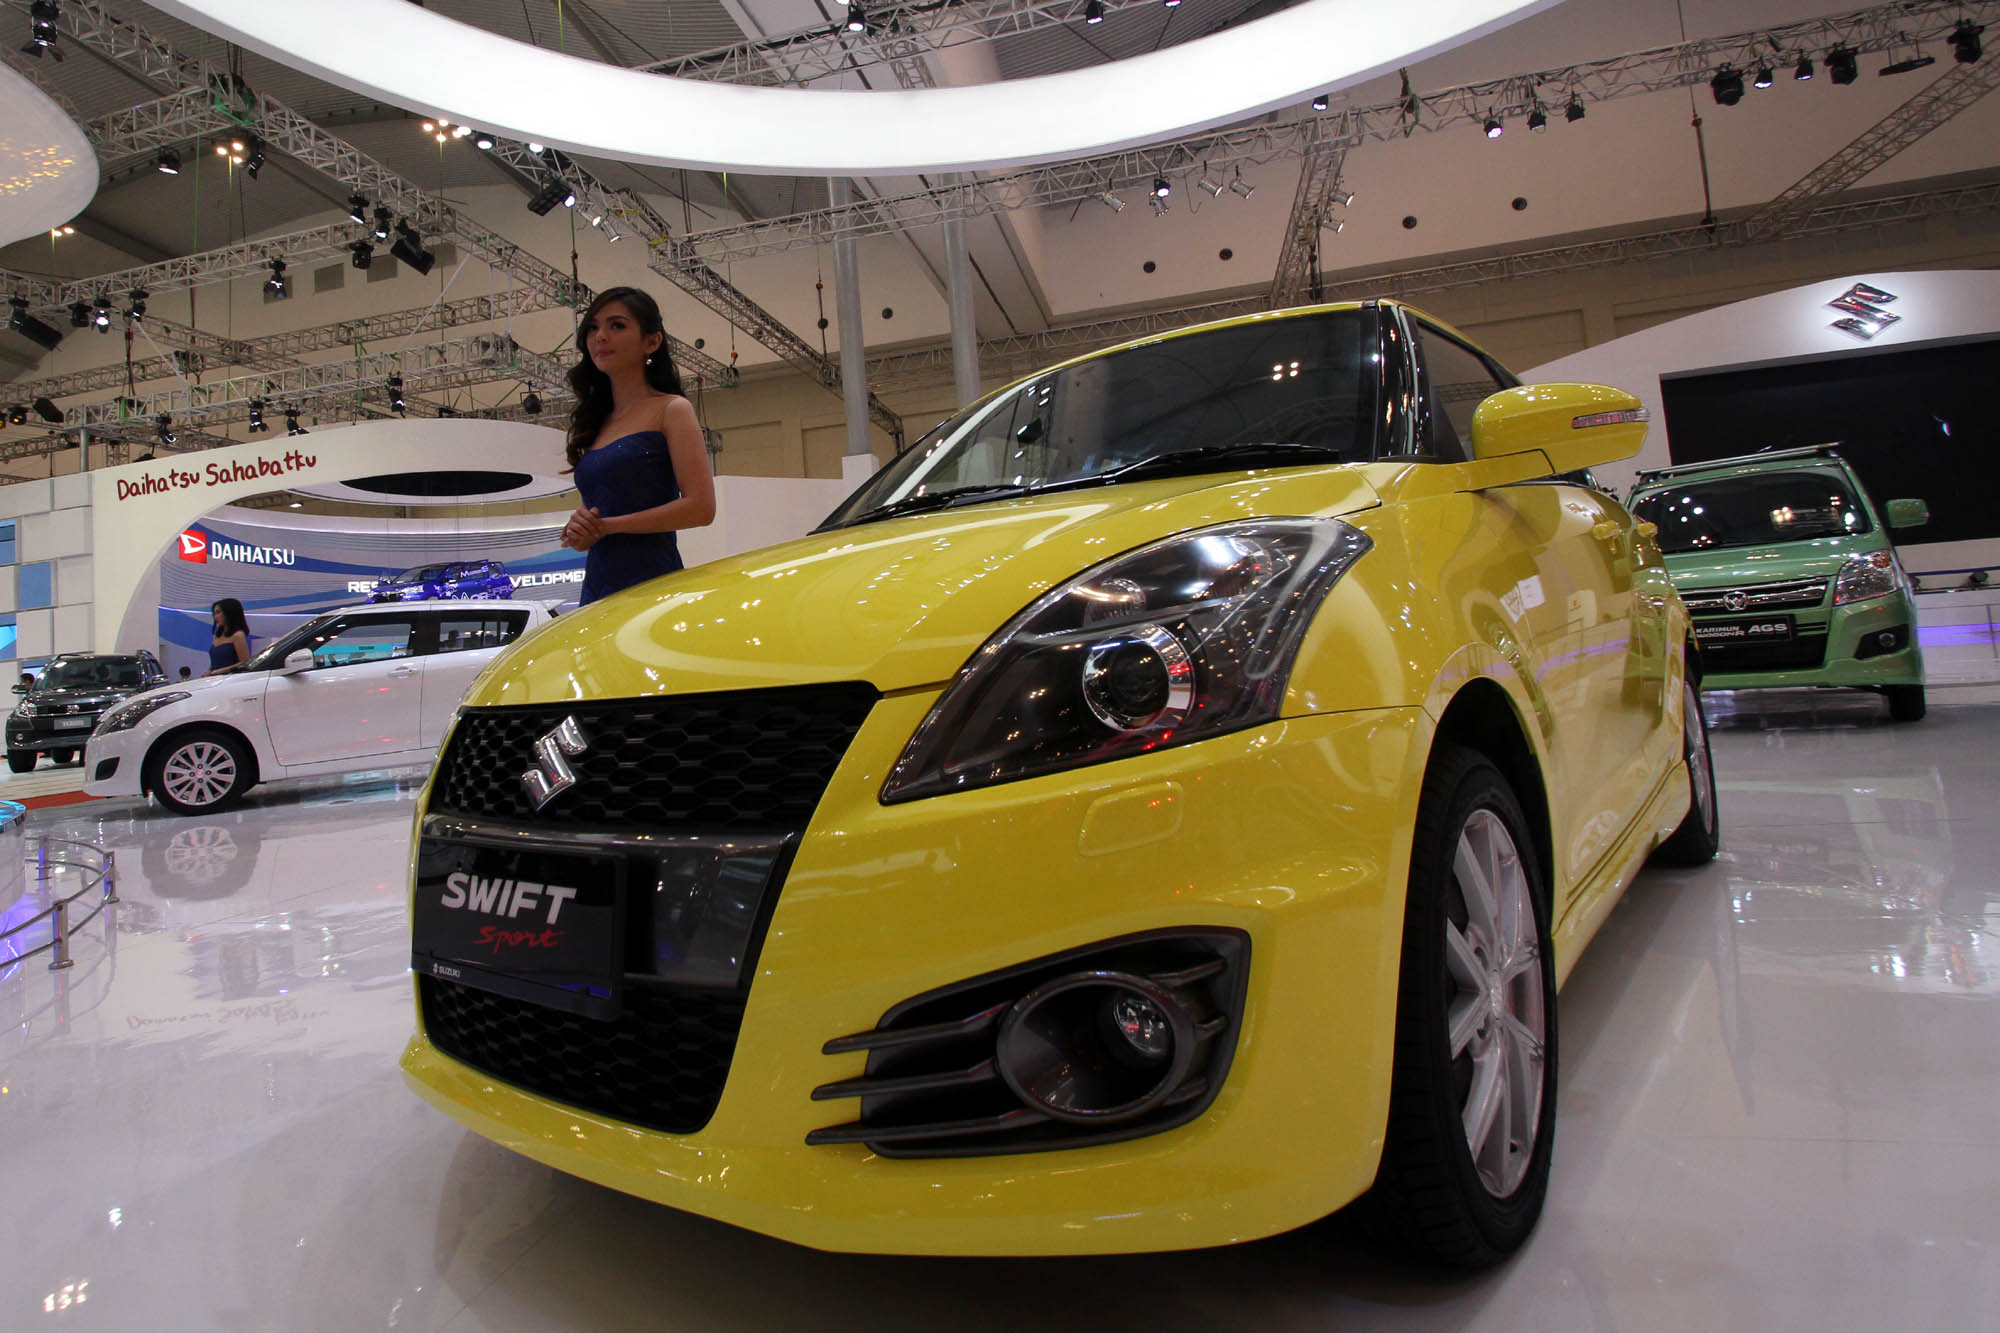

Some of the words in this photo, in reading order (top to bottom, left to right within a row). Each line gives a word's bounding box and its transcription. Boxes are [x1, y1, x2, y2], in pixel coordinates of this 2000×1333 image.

[117, 468, 200, 501] Daihatsu
[206, 449, 317, 486] Sahabatku
[211, 541, 295, 565] DAIHATSU
[1748, 623, 1788, 633] AGS
[441, 872, 577, 925] SWIFT
[472, 925, 568, 955] Sport
